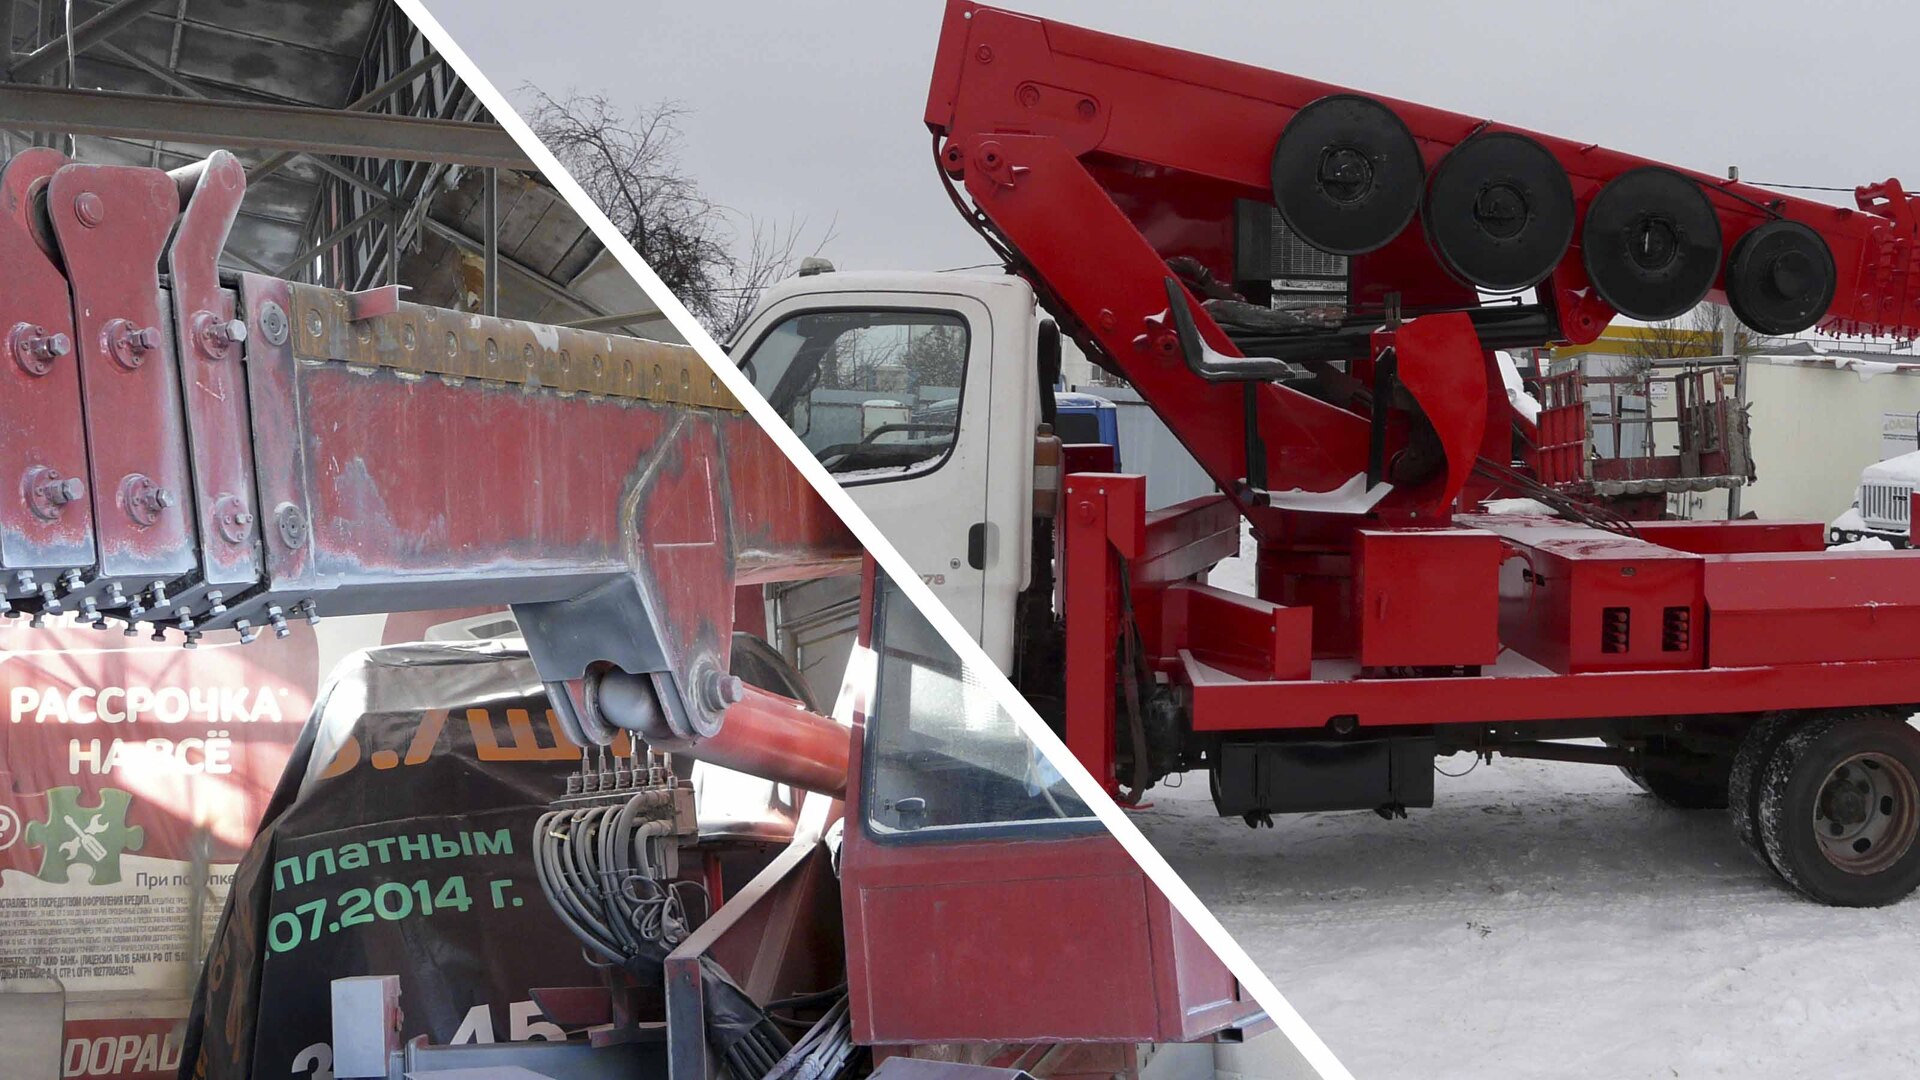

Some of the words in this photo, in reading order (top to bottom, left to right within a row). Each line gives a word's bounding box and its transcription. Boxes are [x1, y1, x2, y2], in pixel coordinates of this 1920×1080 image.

[136, 872, 168, 890] При
[490, 879, 523, 909] г.
[131, 952, 152, 964] БАНКА
[153, 952, 163, 963] РФ
